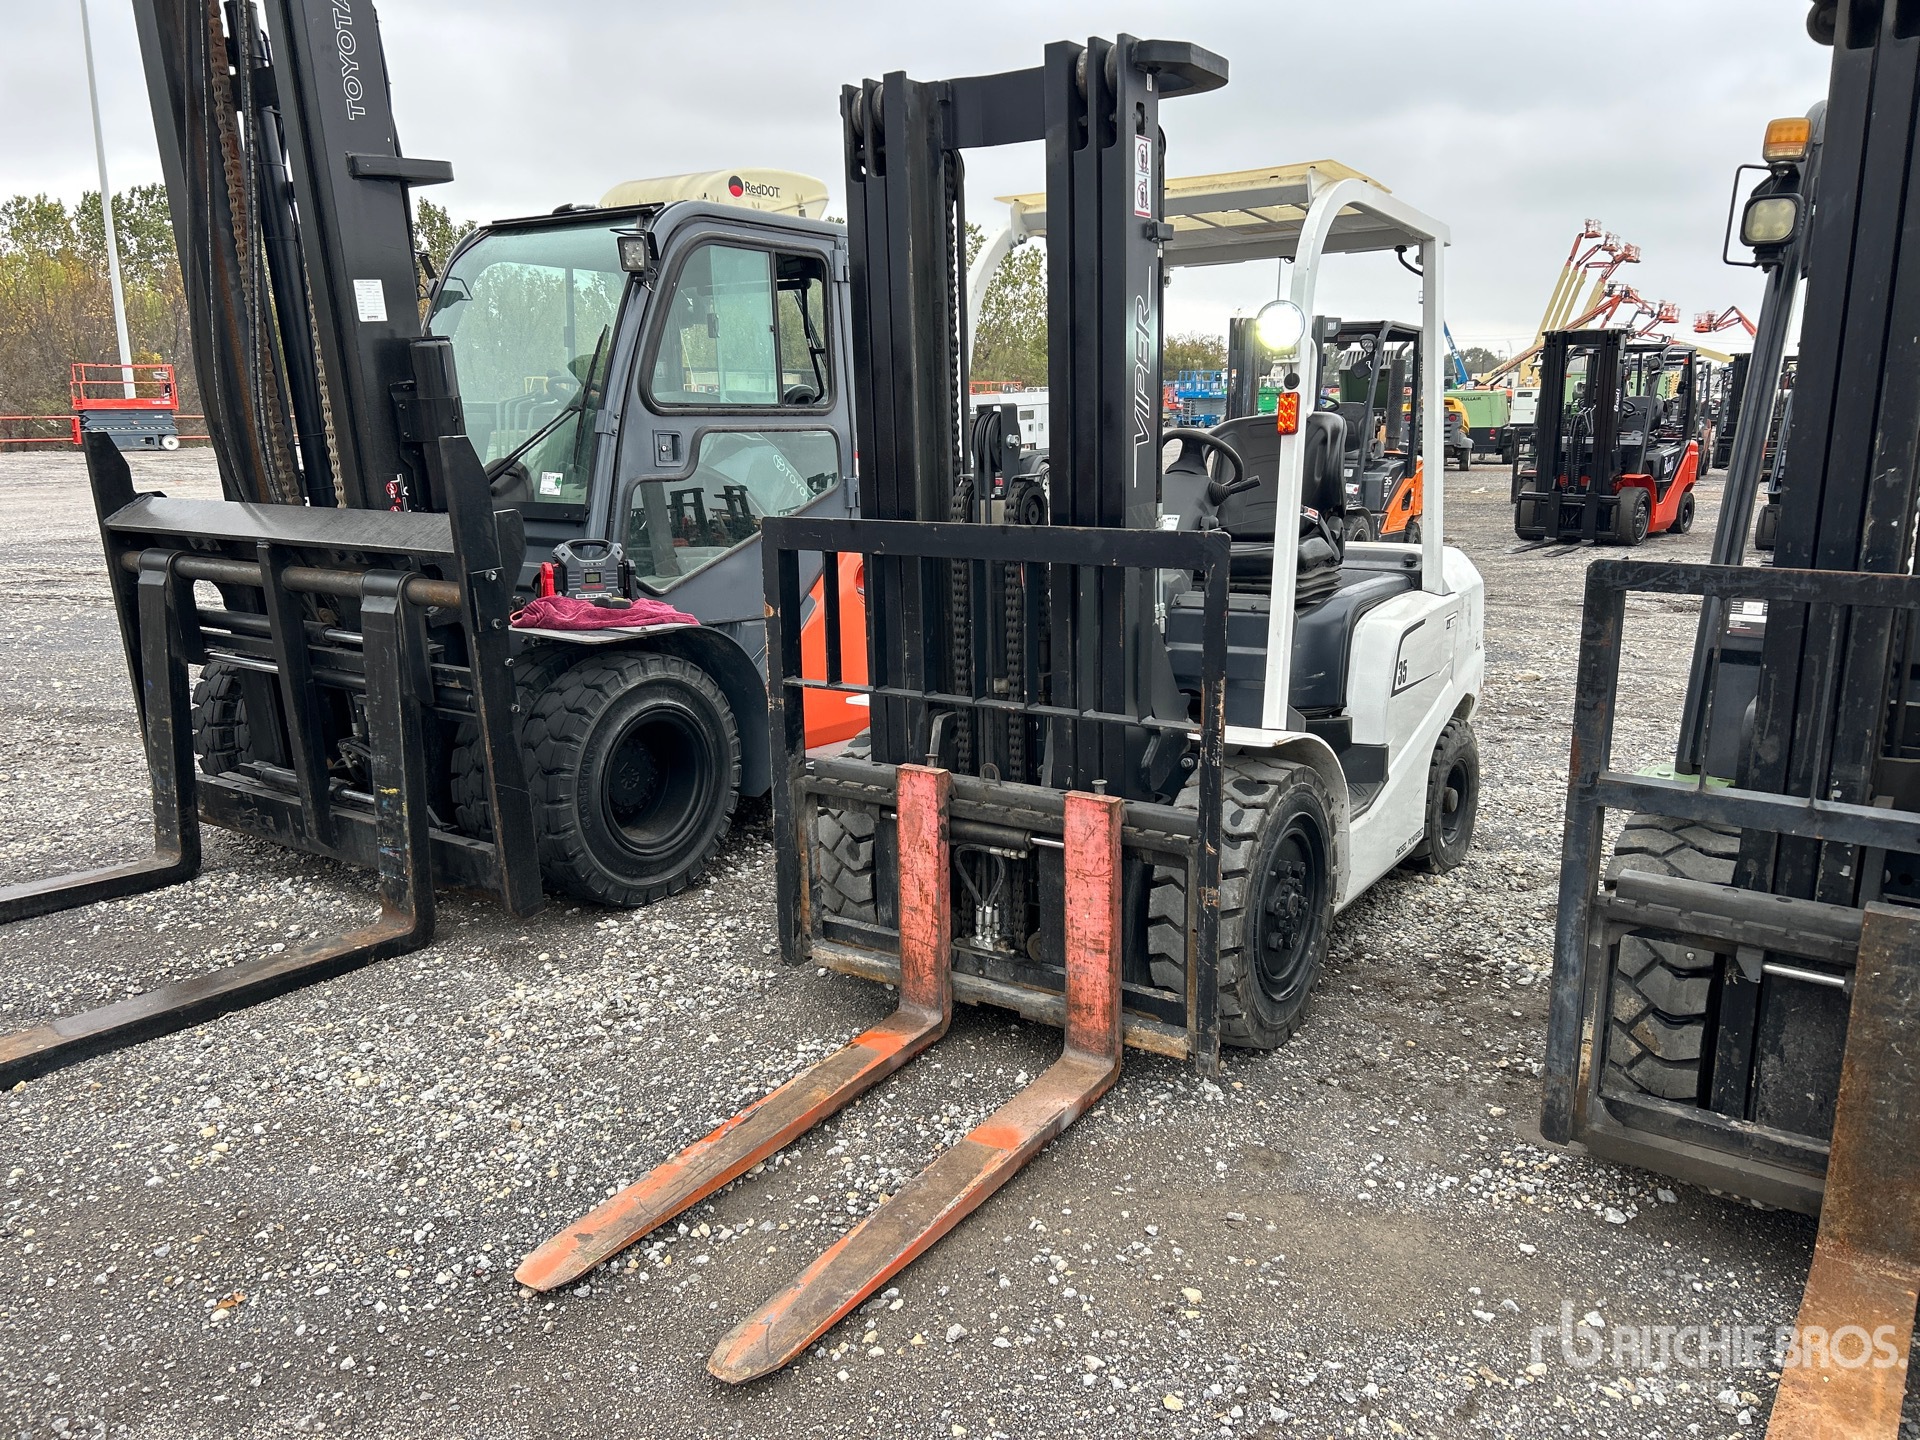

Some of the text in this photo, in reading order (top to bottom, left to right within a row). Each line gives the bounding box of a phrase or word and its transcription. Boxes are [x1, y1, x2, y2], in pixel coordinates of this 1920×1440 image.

[744, 181, 780, 198] RedDOT
[1134, 294, 1151, 448] VIPER
[1384, 476, 1392, 486] 35
[1398, 659, 1407, 685] 35
